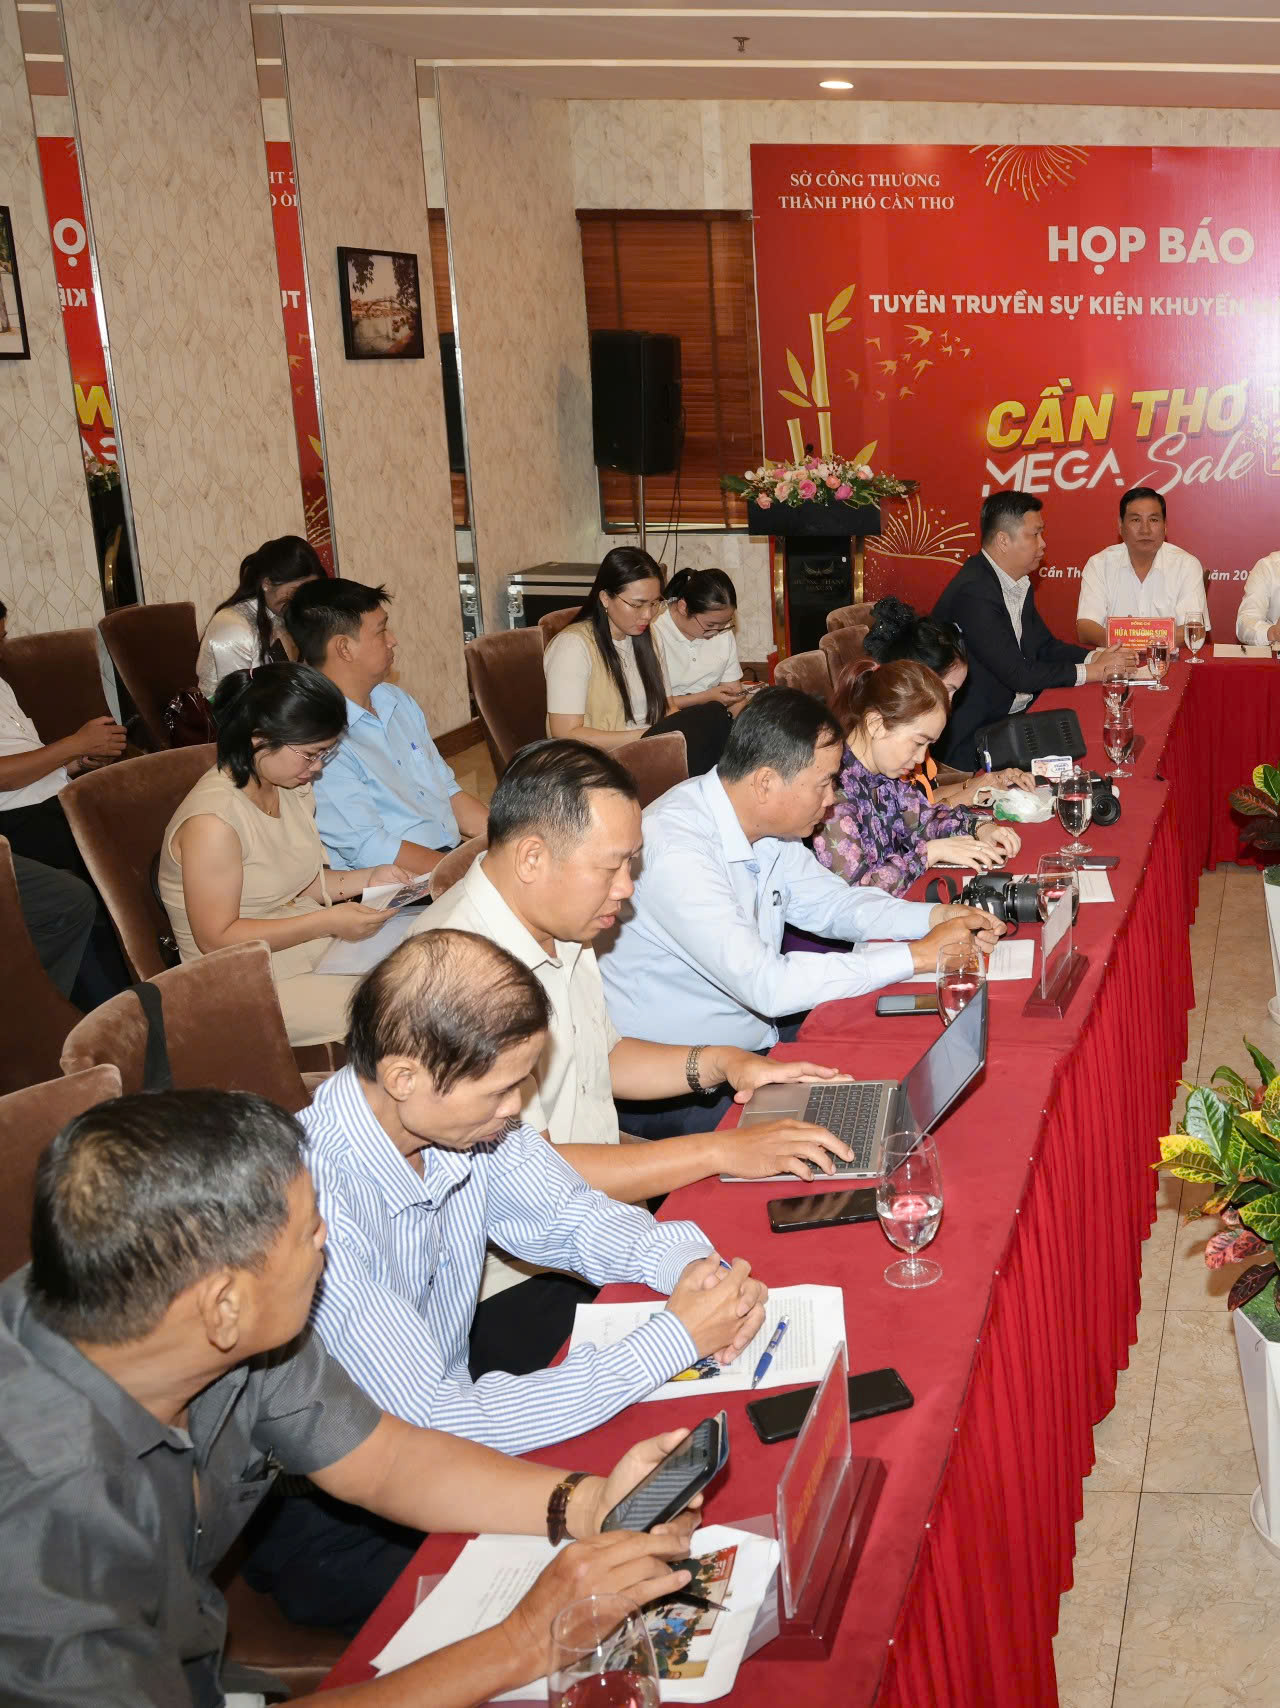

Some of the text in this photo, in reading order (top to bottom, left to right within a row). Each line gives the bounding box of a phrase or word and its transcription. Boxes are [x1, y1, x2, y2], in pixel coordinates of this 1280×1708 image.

[790, 169, 940, 187] SỞ CÔNG THƯƠNG
[777, 192, 956, 210] THÀNH PHỐ CẦN THƠ
[1047, 216, 1255, 275] HỌP BÁO
[869, 289, 946, 313] TUYÊN
[951, 289, 1043, 314] TRUYỀN
[1049, 294, 1084, 320] SỰ
[1089, 291, 1143, 321] KIỆN
[1150, 291, 1245, 317] KHUYẾN
[985, 377, 1251, 448] CẦN THƠ
[981, 431, 1262, 497] MEGA Sale
[1038, 565, 1081, 578] Cần Th
